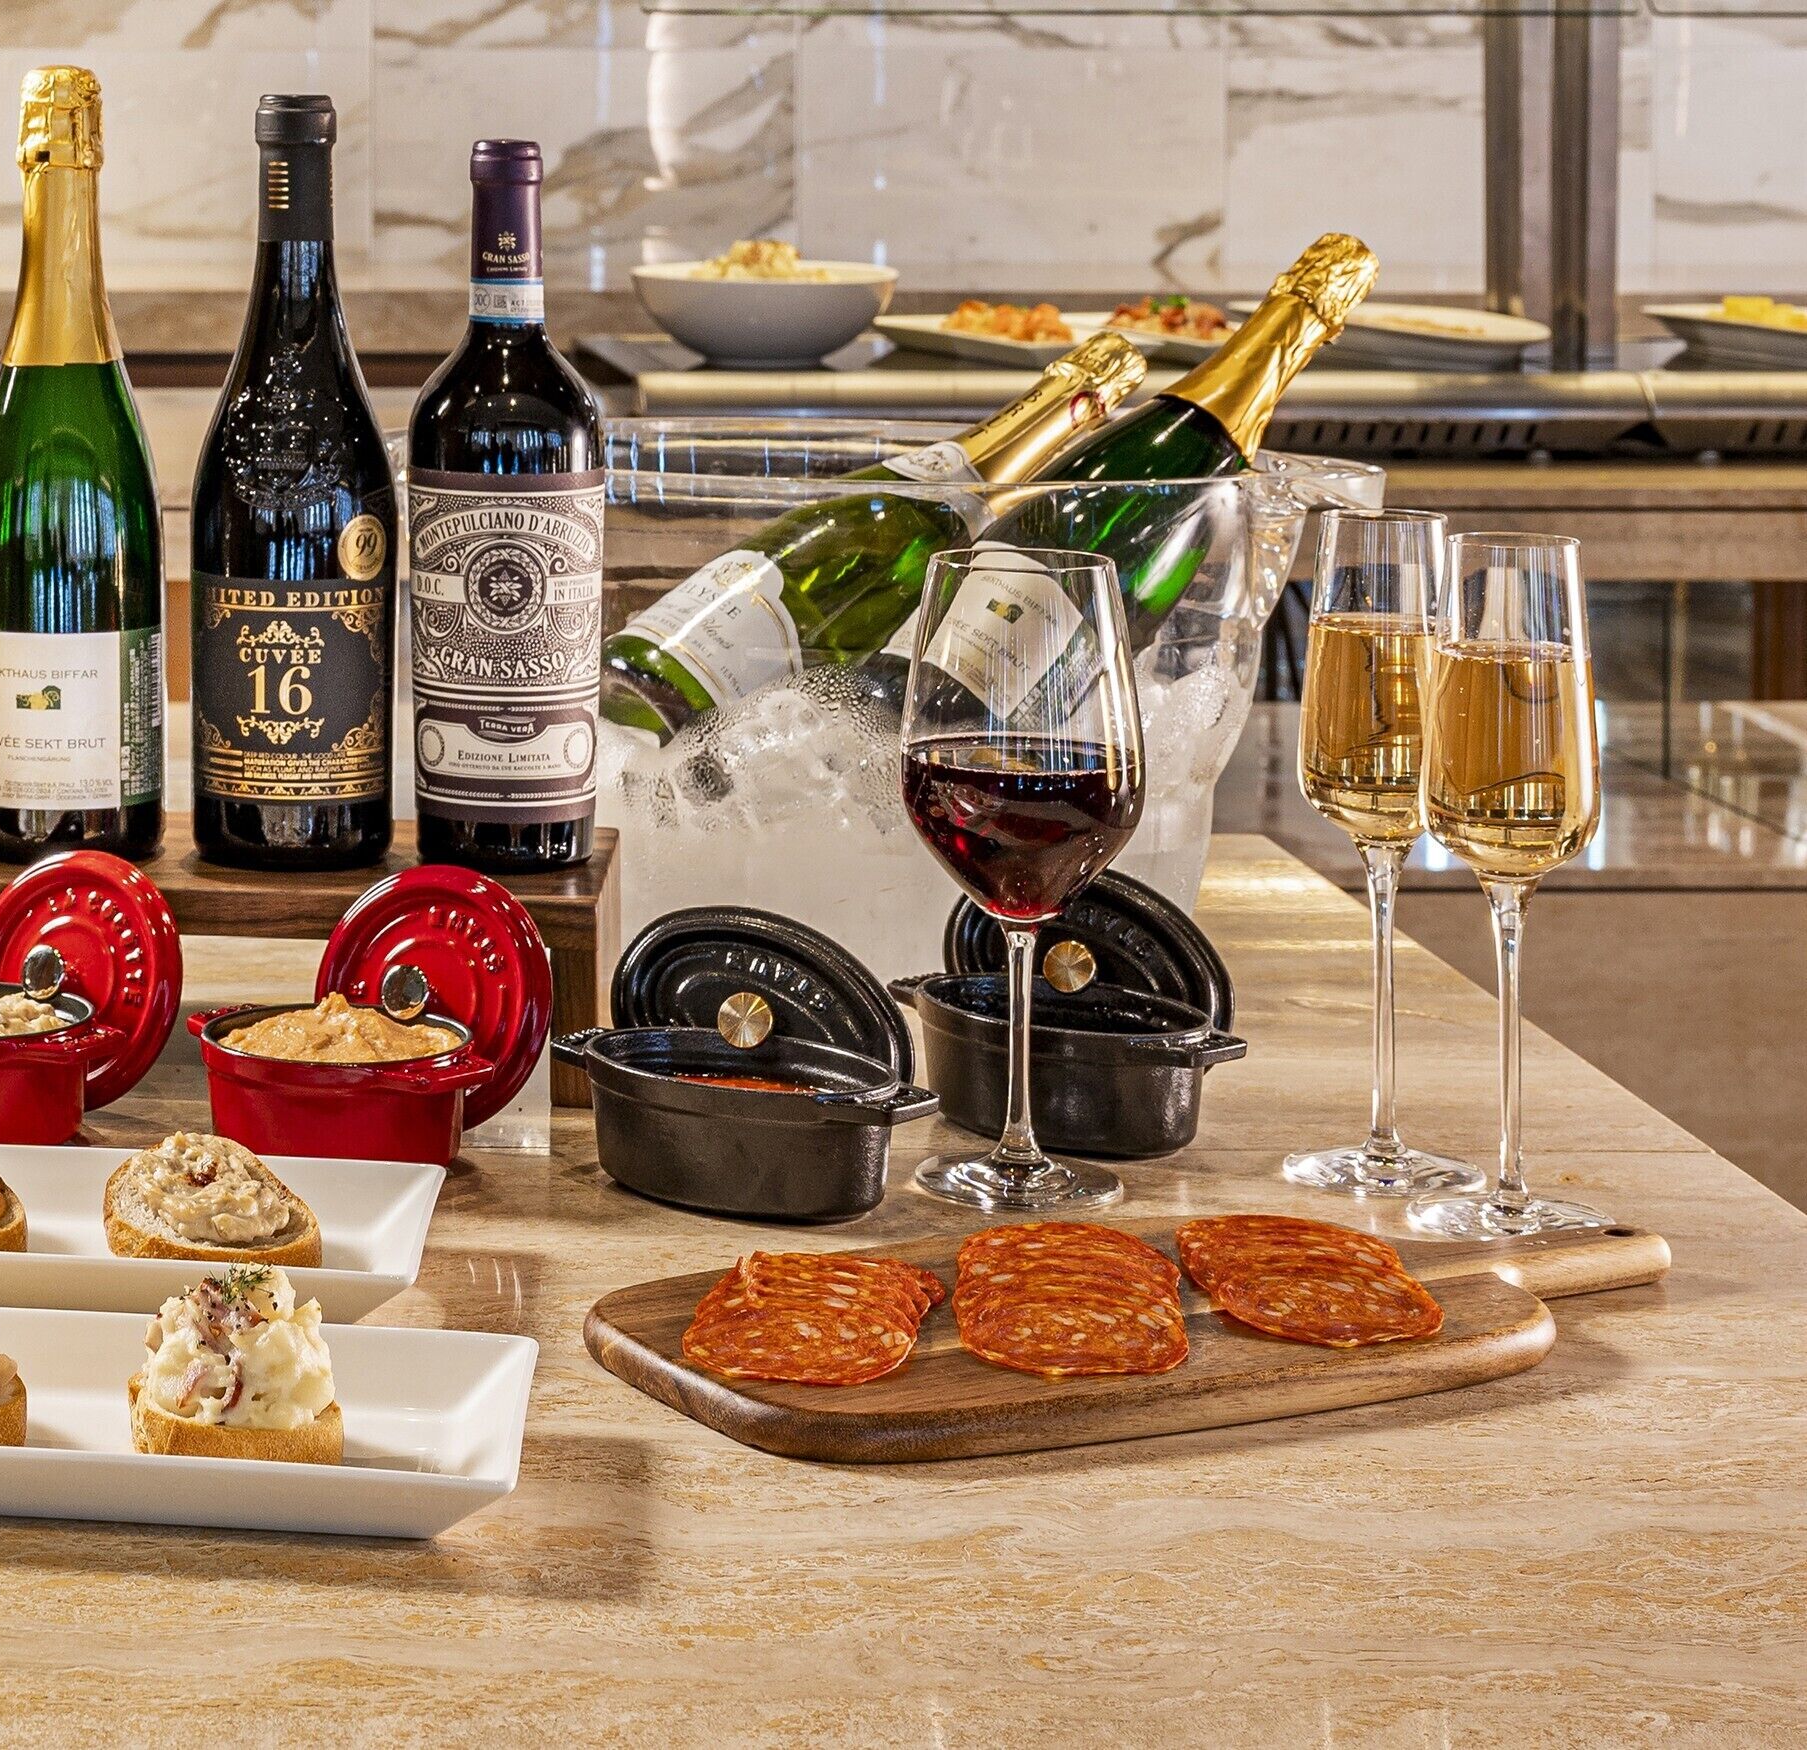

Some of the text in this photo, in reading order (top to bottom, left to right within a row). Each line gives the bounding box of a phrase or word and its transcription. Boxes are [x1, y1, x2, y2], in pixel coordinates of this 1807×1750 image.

[482, 251, 531, 264] GRAN SASSO
[419, 511, 525, 551] MONTEPULCIANO
[529, 516, 591, 554] D'ABRUZZO
[355, 533, 378, 557] 99
[416, 575, 444, 596] D.O.C.
[554, 588, 566, 601] IN
[210, 586, 384, 607] ITED EDITION
[972, 628, 999, 649] SEKT
[238, 643, 321, 665] CUVÉE
[439, 647, 566, 680] GRAN SASSO
[51, 669, 98, 679] BIFFAR
[246, 664, 313, 715] 16
[480, 719, 534, 734] TERRA VERA
[25, 738, 62, 749] SEKT
[67, 737, 106, 749] BRUT
[458, 749, 551, 763] EDIZIONE LIMITATA
